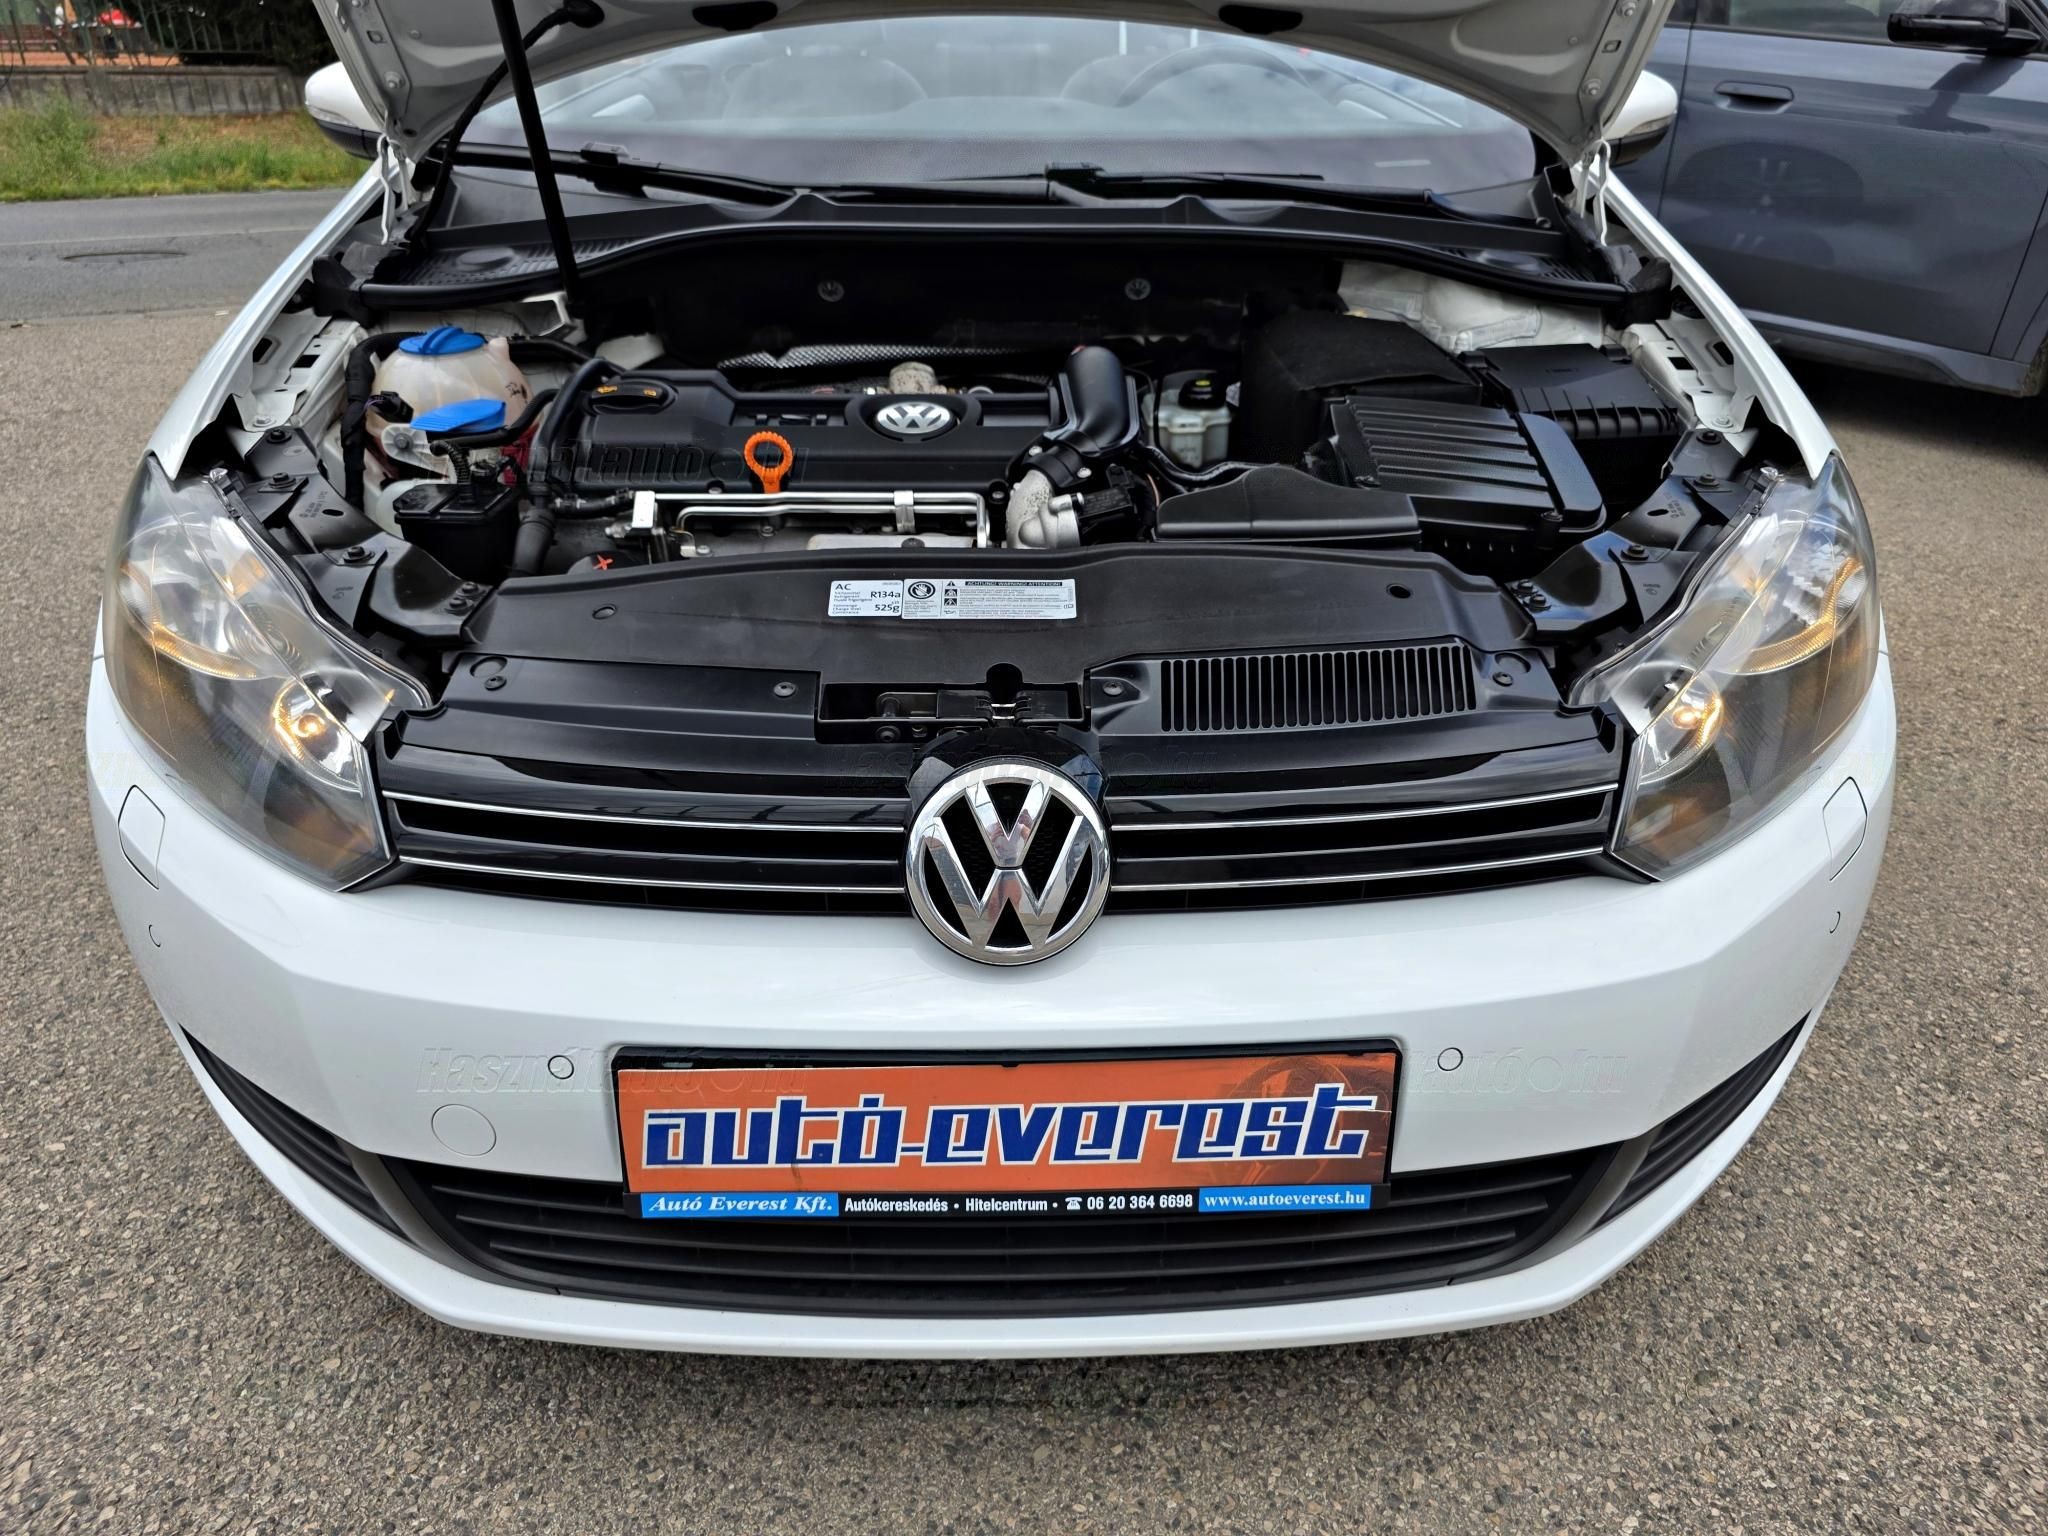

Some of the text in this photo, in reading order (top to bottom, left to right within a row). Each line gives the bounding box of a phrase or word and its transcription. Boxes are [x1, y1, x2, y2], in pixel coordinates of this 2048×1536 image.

[877, 402, 950, 434] VW
[835, 583, 852, 591] AC
[870, 591, 901, 599] R134a
[874, 604, 901, 613] 525g
[906, 763, 1110, 965] VW
[650, 1190, 1366, 1213] Autó Everest Kft. Autókereskedés Hitelcentrum 06 20 364 6698 www.autoeverest.hu
